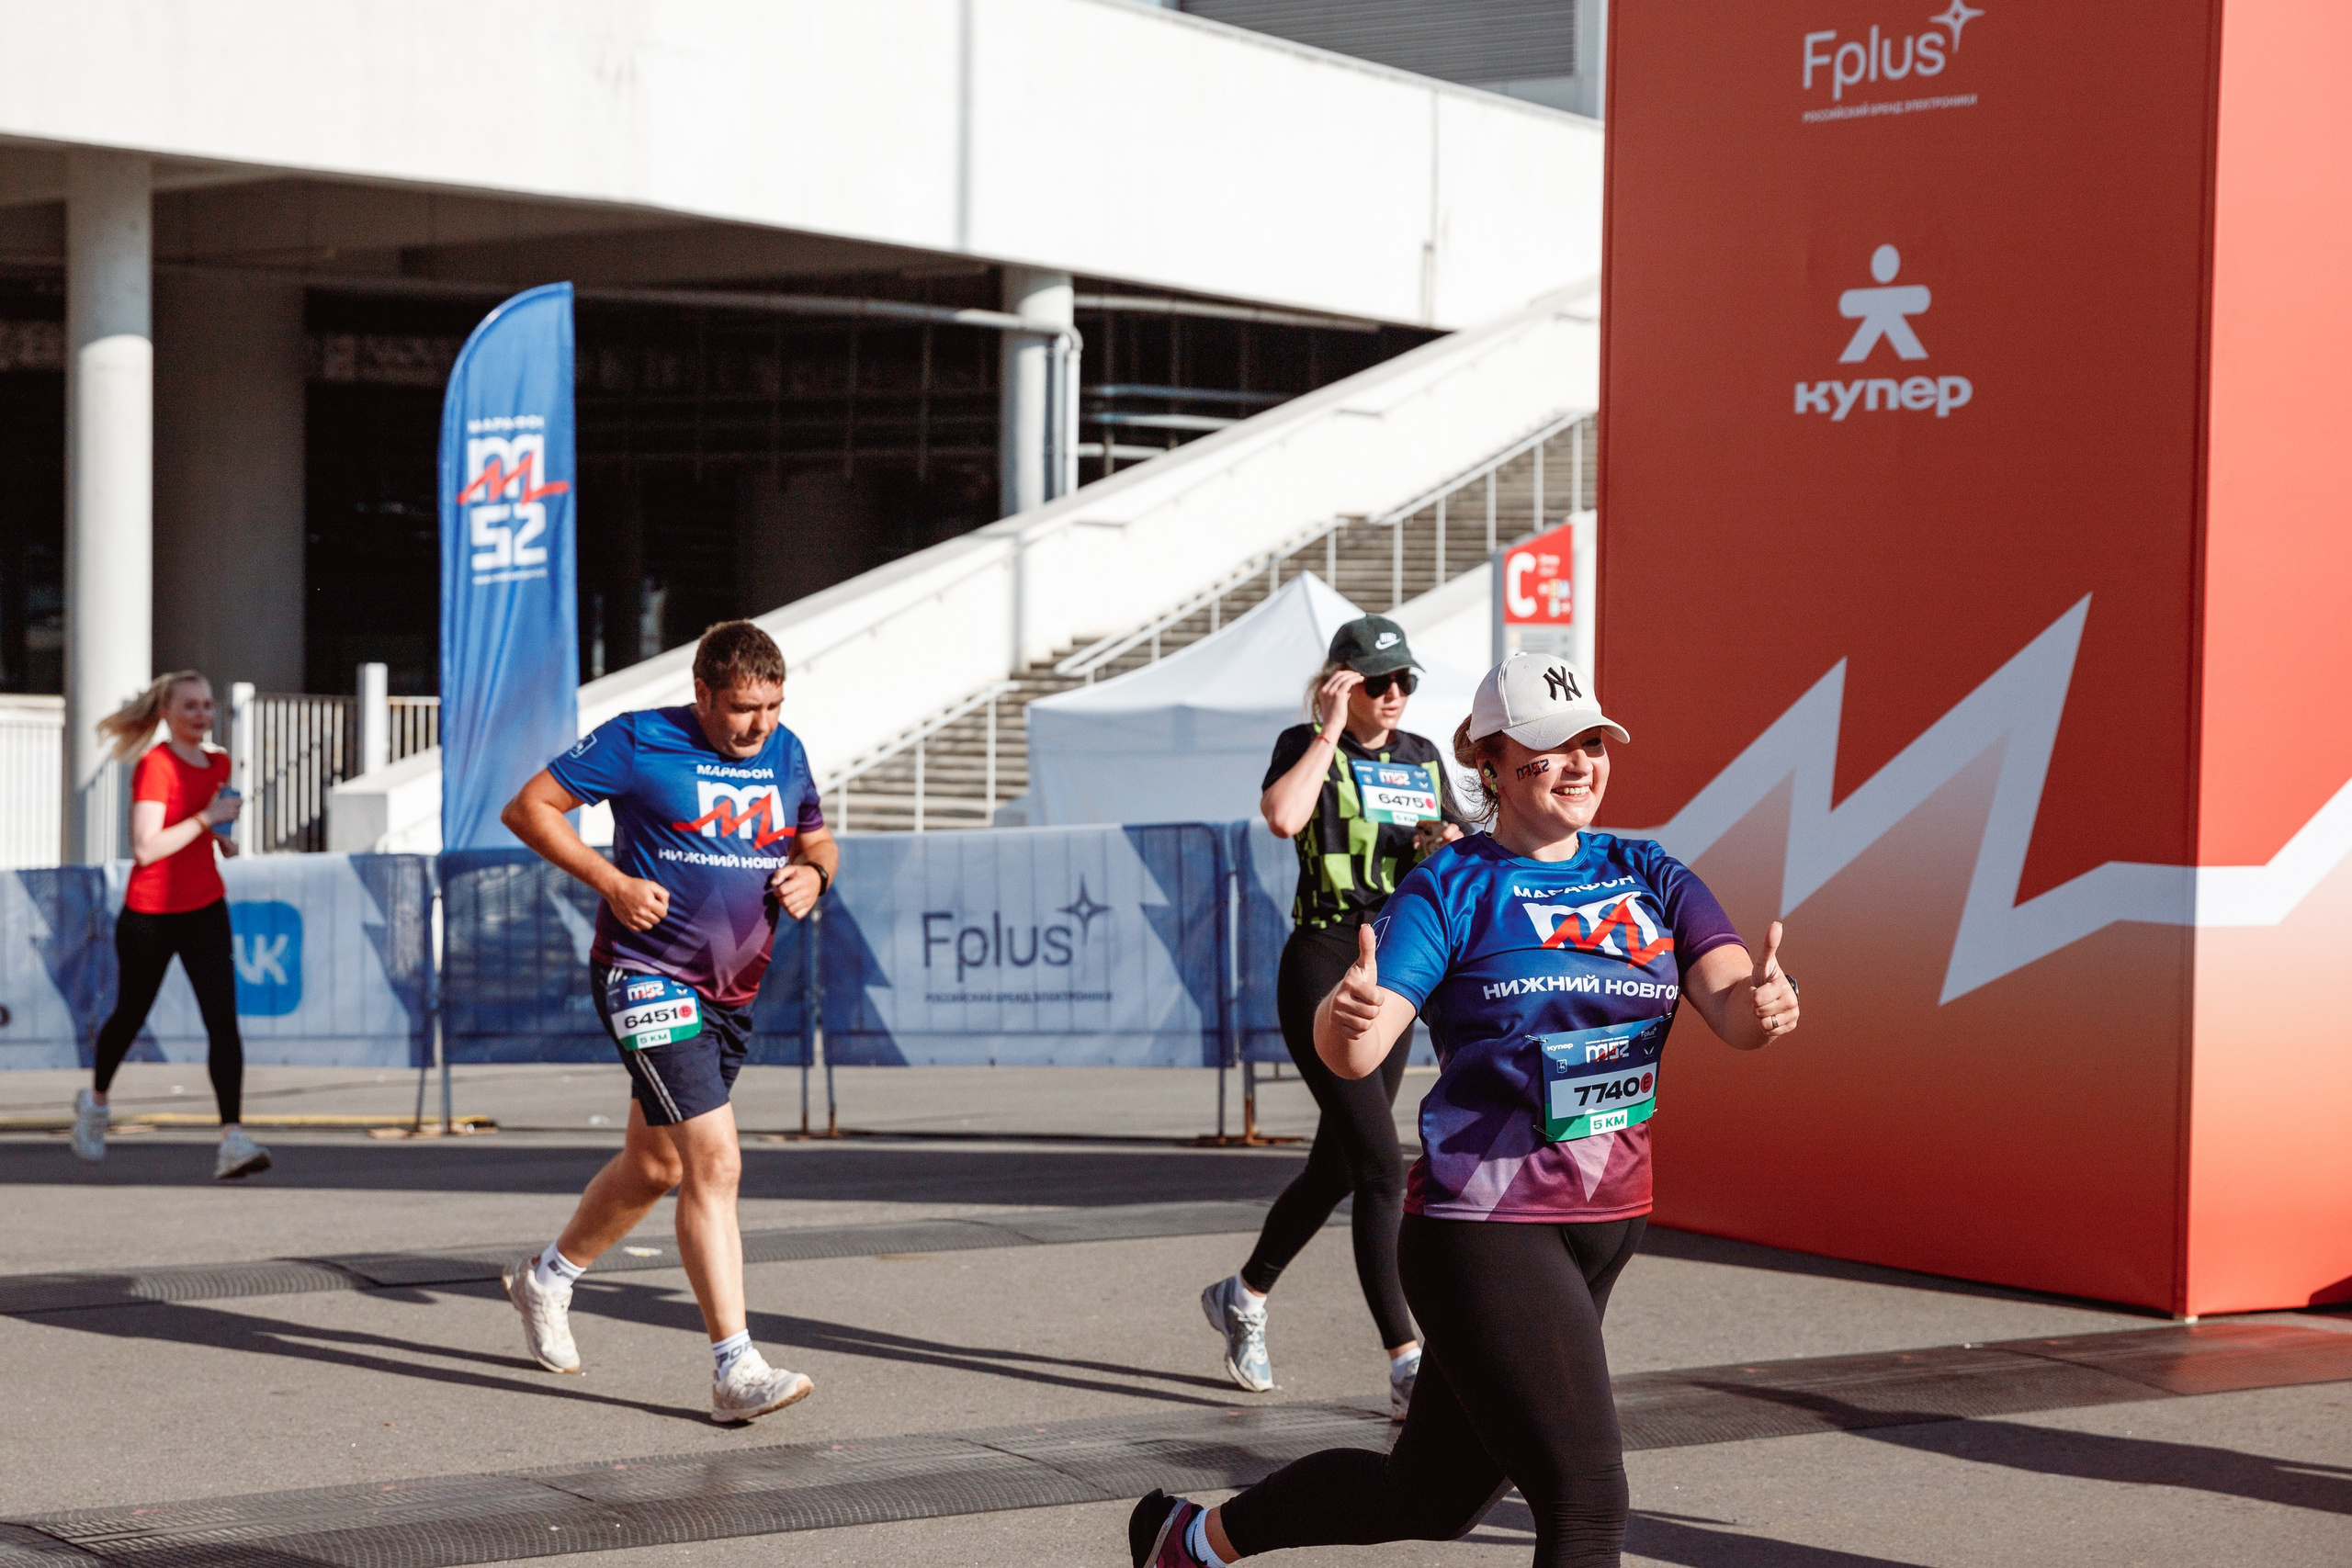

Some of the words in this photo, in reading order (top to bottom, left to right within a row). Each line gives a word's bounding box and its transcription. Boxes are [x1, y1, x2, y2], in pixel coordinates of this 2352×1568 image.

[1803, 24, 1946, 101] Fplus
[1794, 376, 1973, 422] купер
[696, 764, 775, 779] МАРАФОН
[1378, 793, 1424, 808] 6475
[658, 848, 740, 868] НИЖНИЙ
[741, 855, 789, 869] НОВГО
[922, 911, 1073, 983] Fplus
[1483, 974, 1600, 1000] НИЖНИЙ
[625, 1007, 678, 1029] 6451
[650, 1032, 668, 1042] KM
[1574, 1077, 1640, 1107] 7740
[1643, 1075, 1651, 1089] E
[1593, 1120, 1602, 1130] 5
[1605, 1114, 1625, 1128] KM
